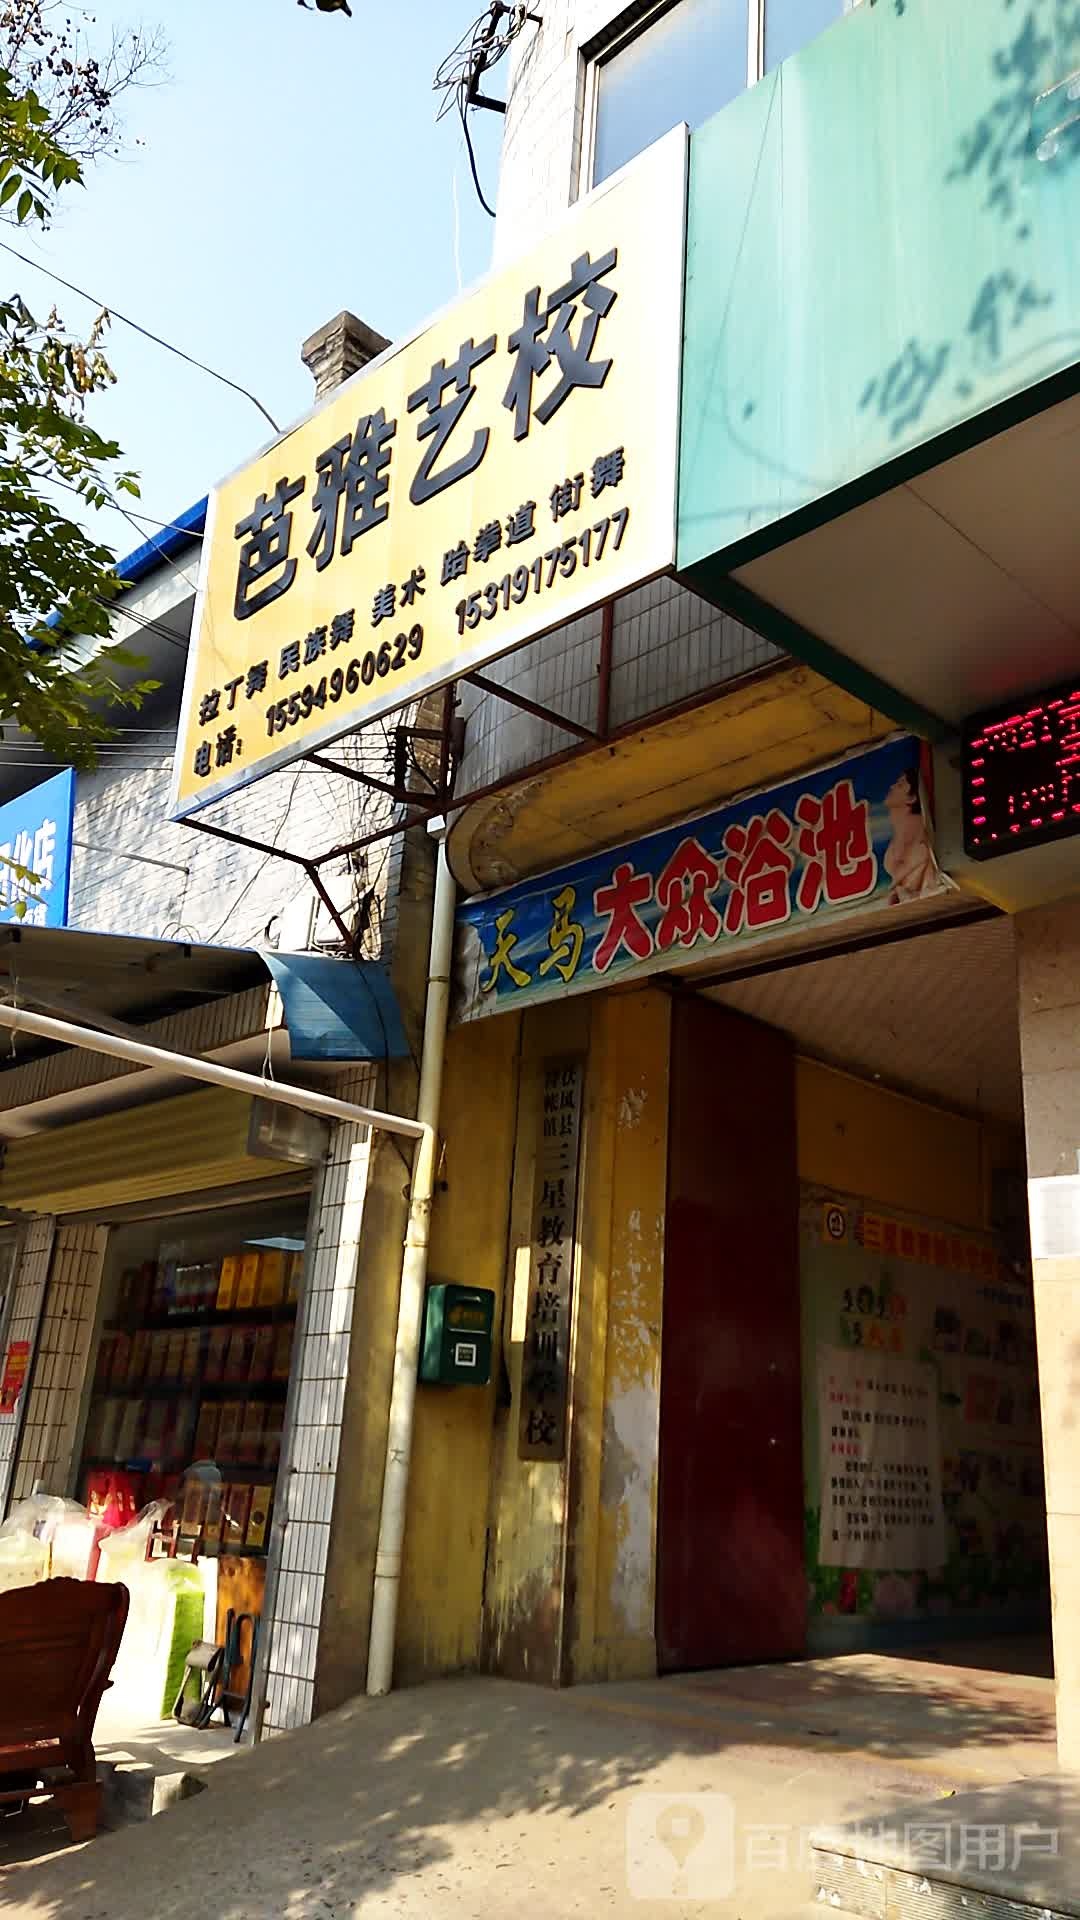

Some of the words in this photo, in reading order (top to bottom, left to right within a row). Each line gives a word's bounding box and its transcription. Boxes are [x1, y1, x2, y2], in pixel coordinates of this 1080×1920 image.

[233, 247, 618, 620] 芭雅艺校
[199, 660, 268, 726] 拉丁舞
[278, 608, 355, 680] 民族舞
[370, 564, 425, 627] 美术
[440, 500, 537, 587] 跆拳道
[549, 445, 625, 523] 街舞
[455, 506, 630, 635] 15319175177
[480, 886, 585, 993] 天马
[591, 778, 877, 975] 大众浴池
